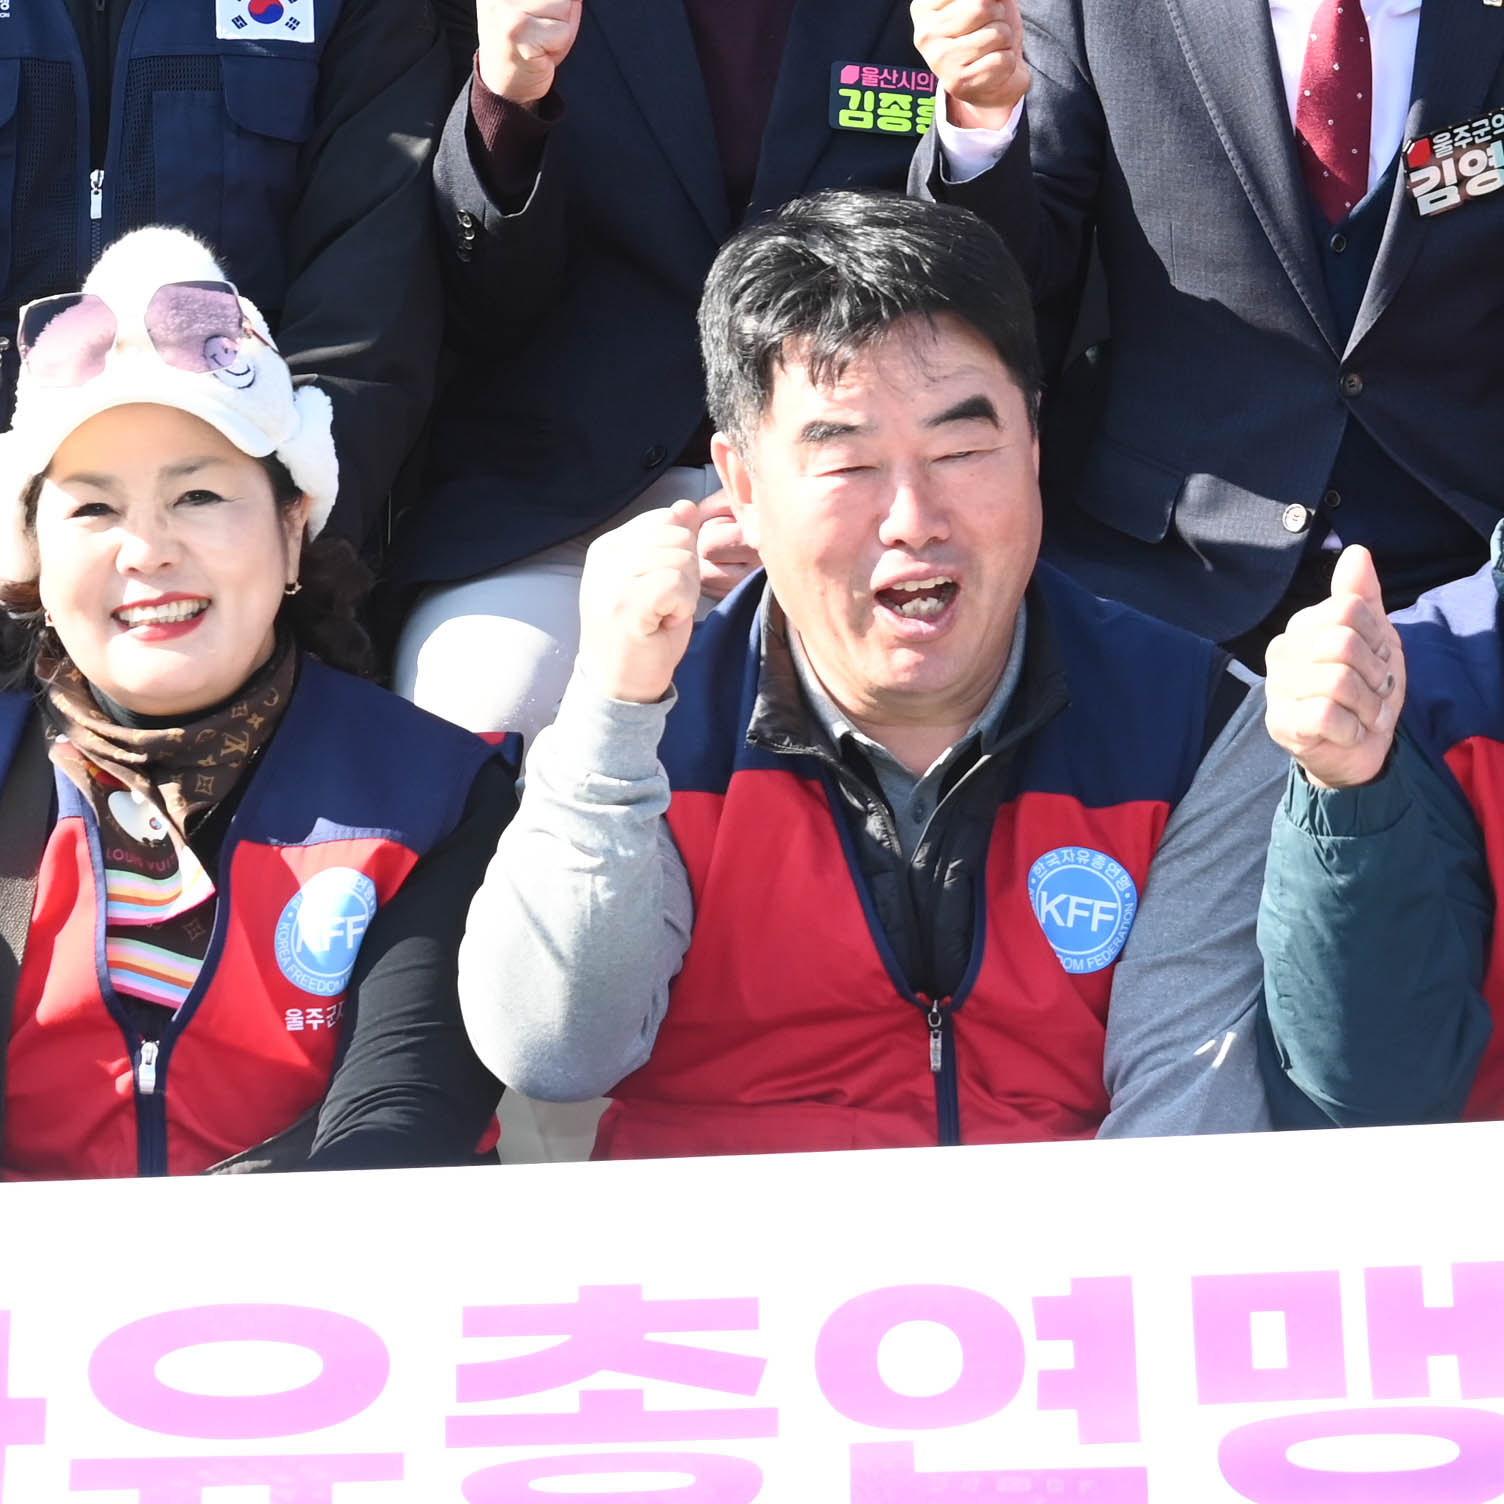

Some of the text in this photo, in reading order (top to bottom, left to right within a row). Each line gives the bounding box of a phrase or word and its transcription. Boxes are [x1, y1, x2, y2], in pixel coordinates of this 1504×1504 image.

[861, 66, 935, 93] 울산시의
[1033, 848, 1131, 892] 한국자유총연맹
[1040, 890, 1117, 932] KFF
[1087, 902, 1135, 969] FEDERATION
